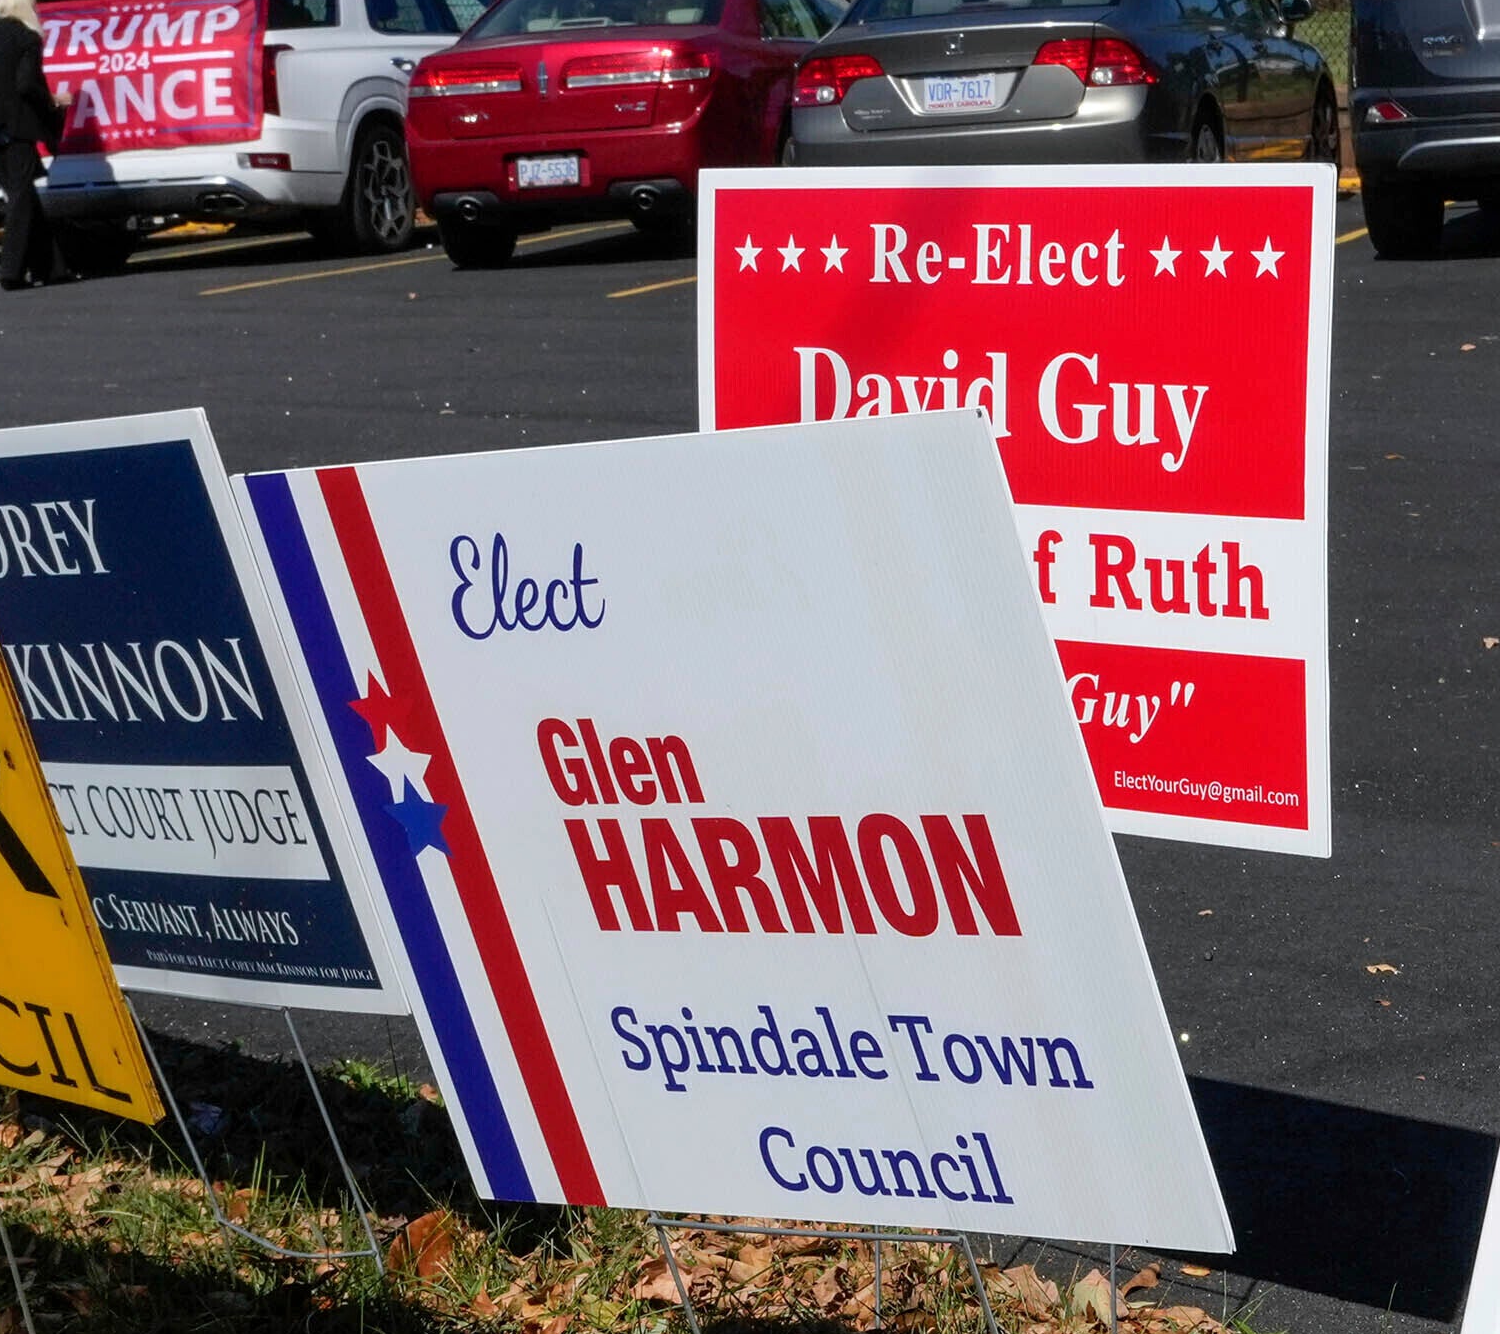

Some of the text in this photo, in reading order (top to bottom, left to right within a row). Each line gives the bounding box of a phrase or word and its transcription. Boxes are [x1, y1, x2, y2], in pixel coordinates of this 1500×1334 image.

[43, 5, 240, 57] TRUMP
[99, 51, 150, 74] 2024
[869, 223, 1125, 287] Re-Elect
[794, 347, 1209, 472] David Guy
[450, 533, 605, 640] Elect
[1089, 533, 1269, 620] Ruth
[536, 718, 703, 804] Glen
[1114, 771, 1299, 806] ElectYourGuy@gmail.com
[87, 784, 194, 842] COURT
[190, 788, 307, 859] JUDGE
[566, 812, 1022, 936] HARMON
[209, 901, 298, 946] ALWAYS
[612, 1006, 1093, 1092] Spindale Town
[760, 1126, 1014, 1205] Council
